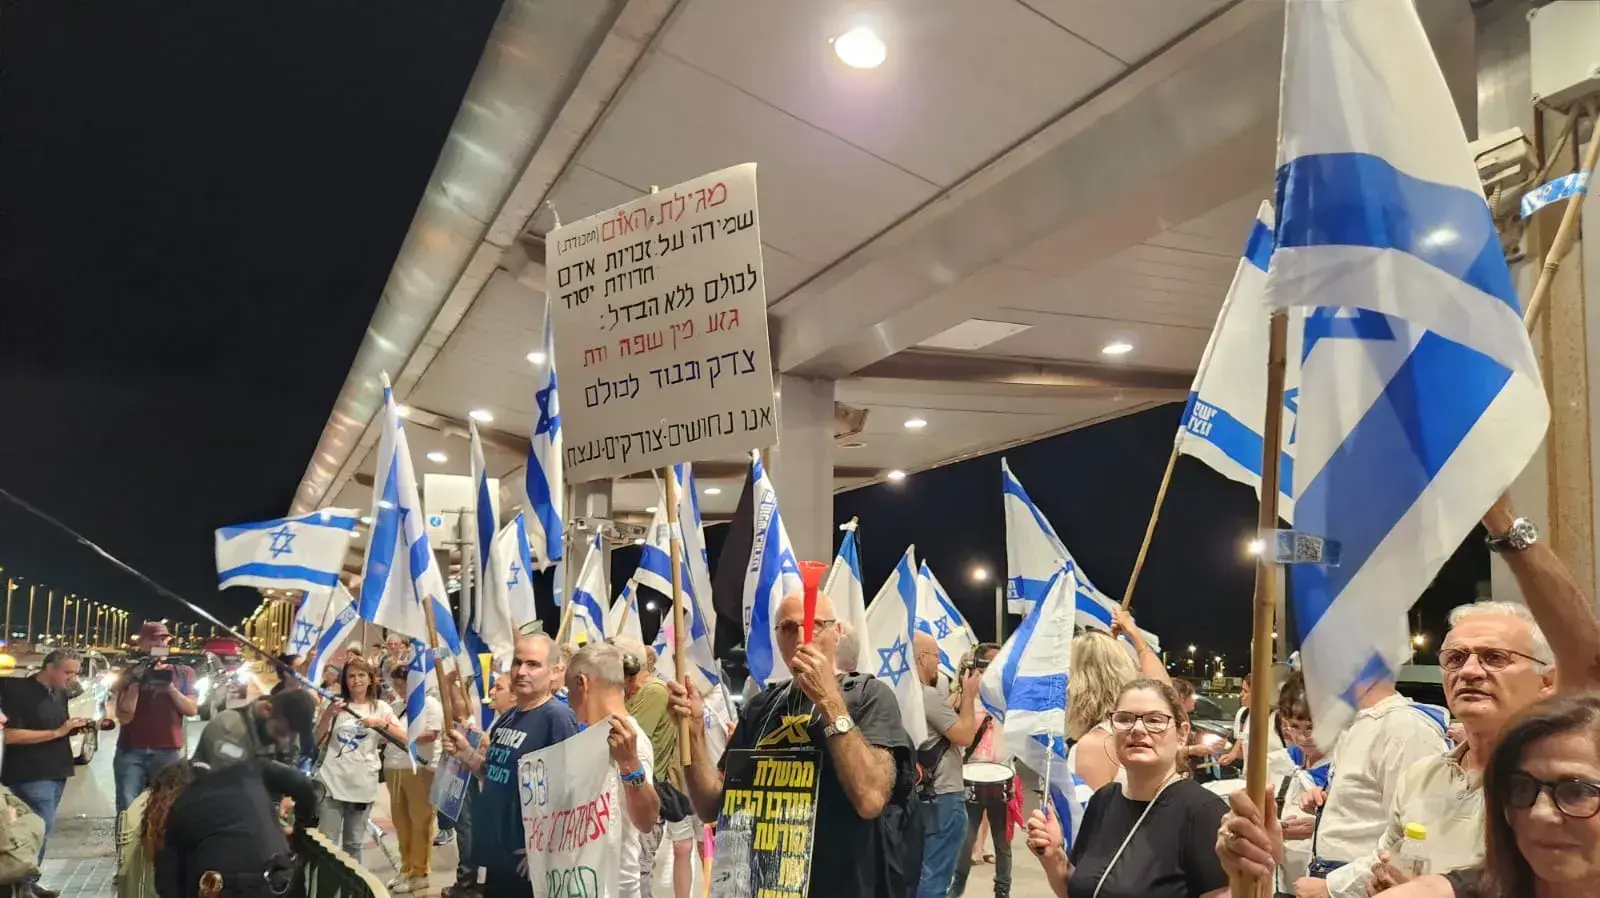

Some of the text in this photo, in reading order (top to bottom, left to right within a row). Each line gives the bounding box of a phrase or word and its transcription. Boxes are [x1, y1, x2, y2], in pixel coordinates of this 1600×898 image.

[657, 182, 727, 226] מגילת
[691, 210, 754, 244] שמירה
[605, 239, 651, 272] זכויות
[558, 257, 595, 287] אדם
[704, 264, 757, 303] לכולם
[561, 285, 594, 309] יסוד
[665, 283, 694, 314] ללא
[583, 308, 740, 367] גזע מין שפה ודת
[584, 349, 755, 408] צדק וכבוד לכולם
[741, 406, 771, 431] אנו
[753, 758, 815, 788] ממשלת
[722, 789, 811, 820] חורבן הבית
